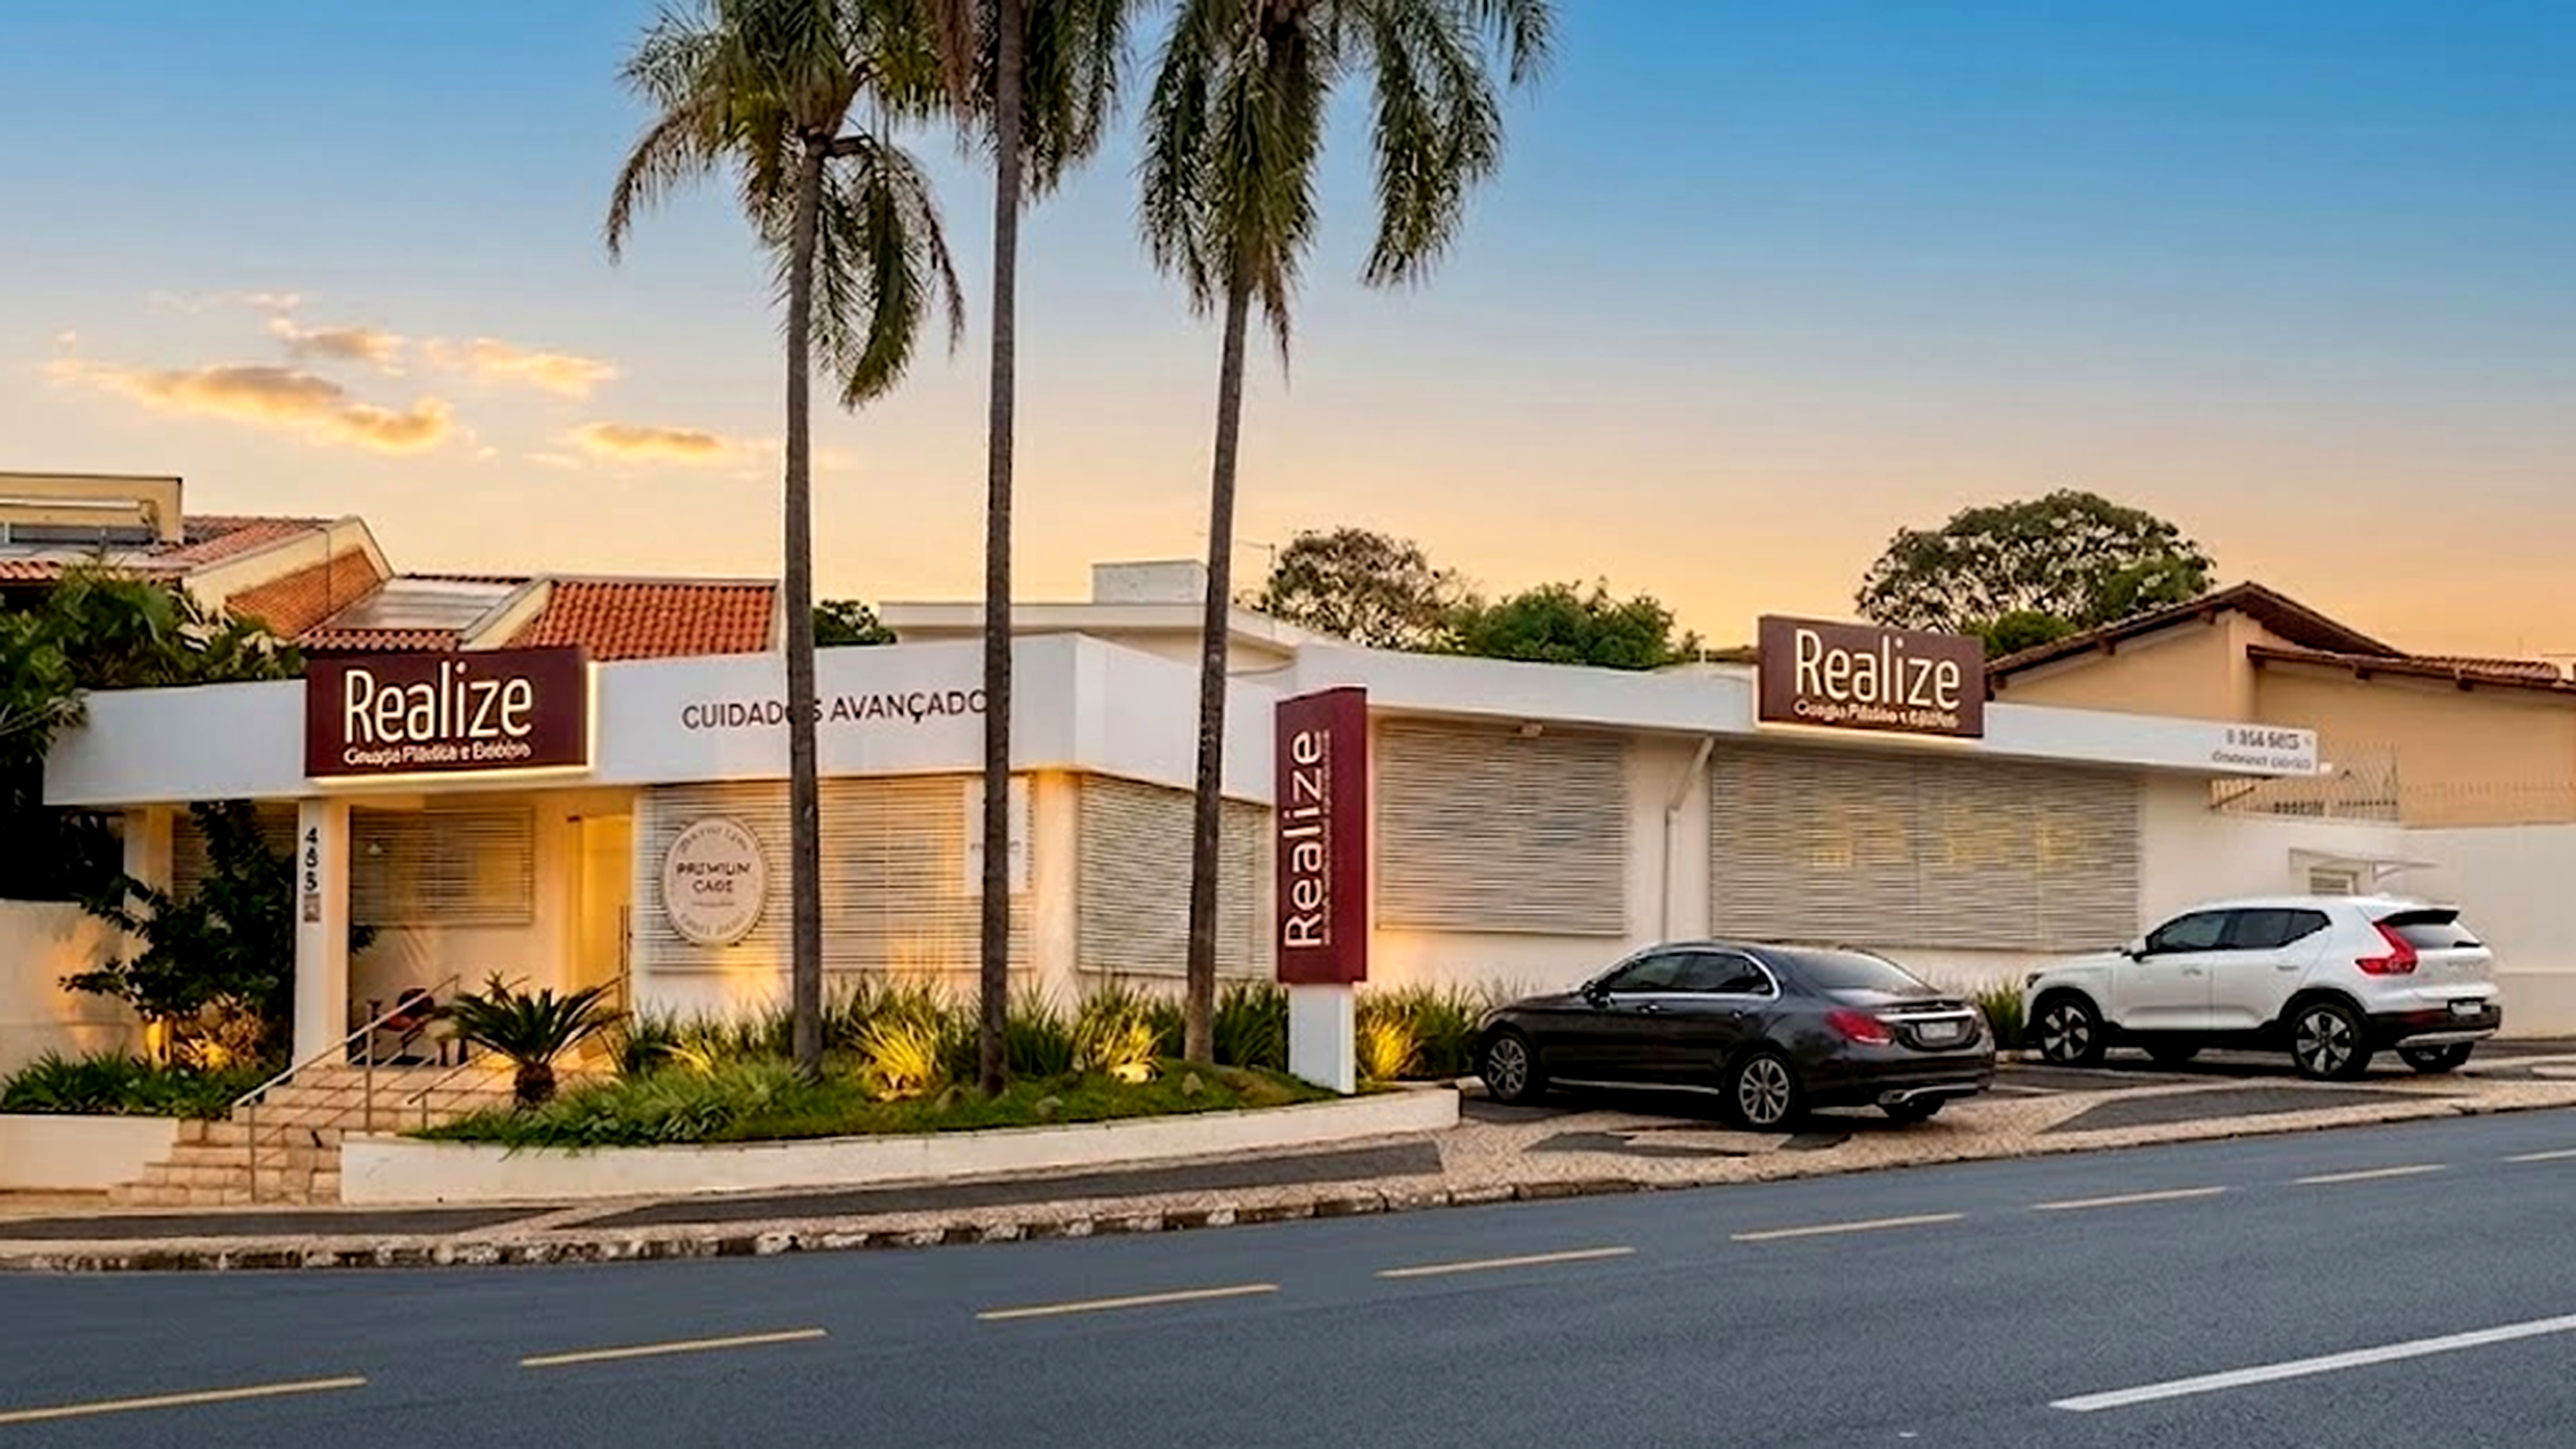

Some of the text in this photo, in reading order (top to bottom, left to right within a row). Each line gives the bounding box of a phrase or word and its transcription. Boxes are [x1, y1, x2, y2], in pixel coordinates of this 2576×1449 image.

[345, 660, 533, 743] Realize
[1795, 628, 1960, 710] Realize
[682, 699, 823, 730] CUIDADS
[1282, 730, 1322, 947] Realize
